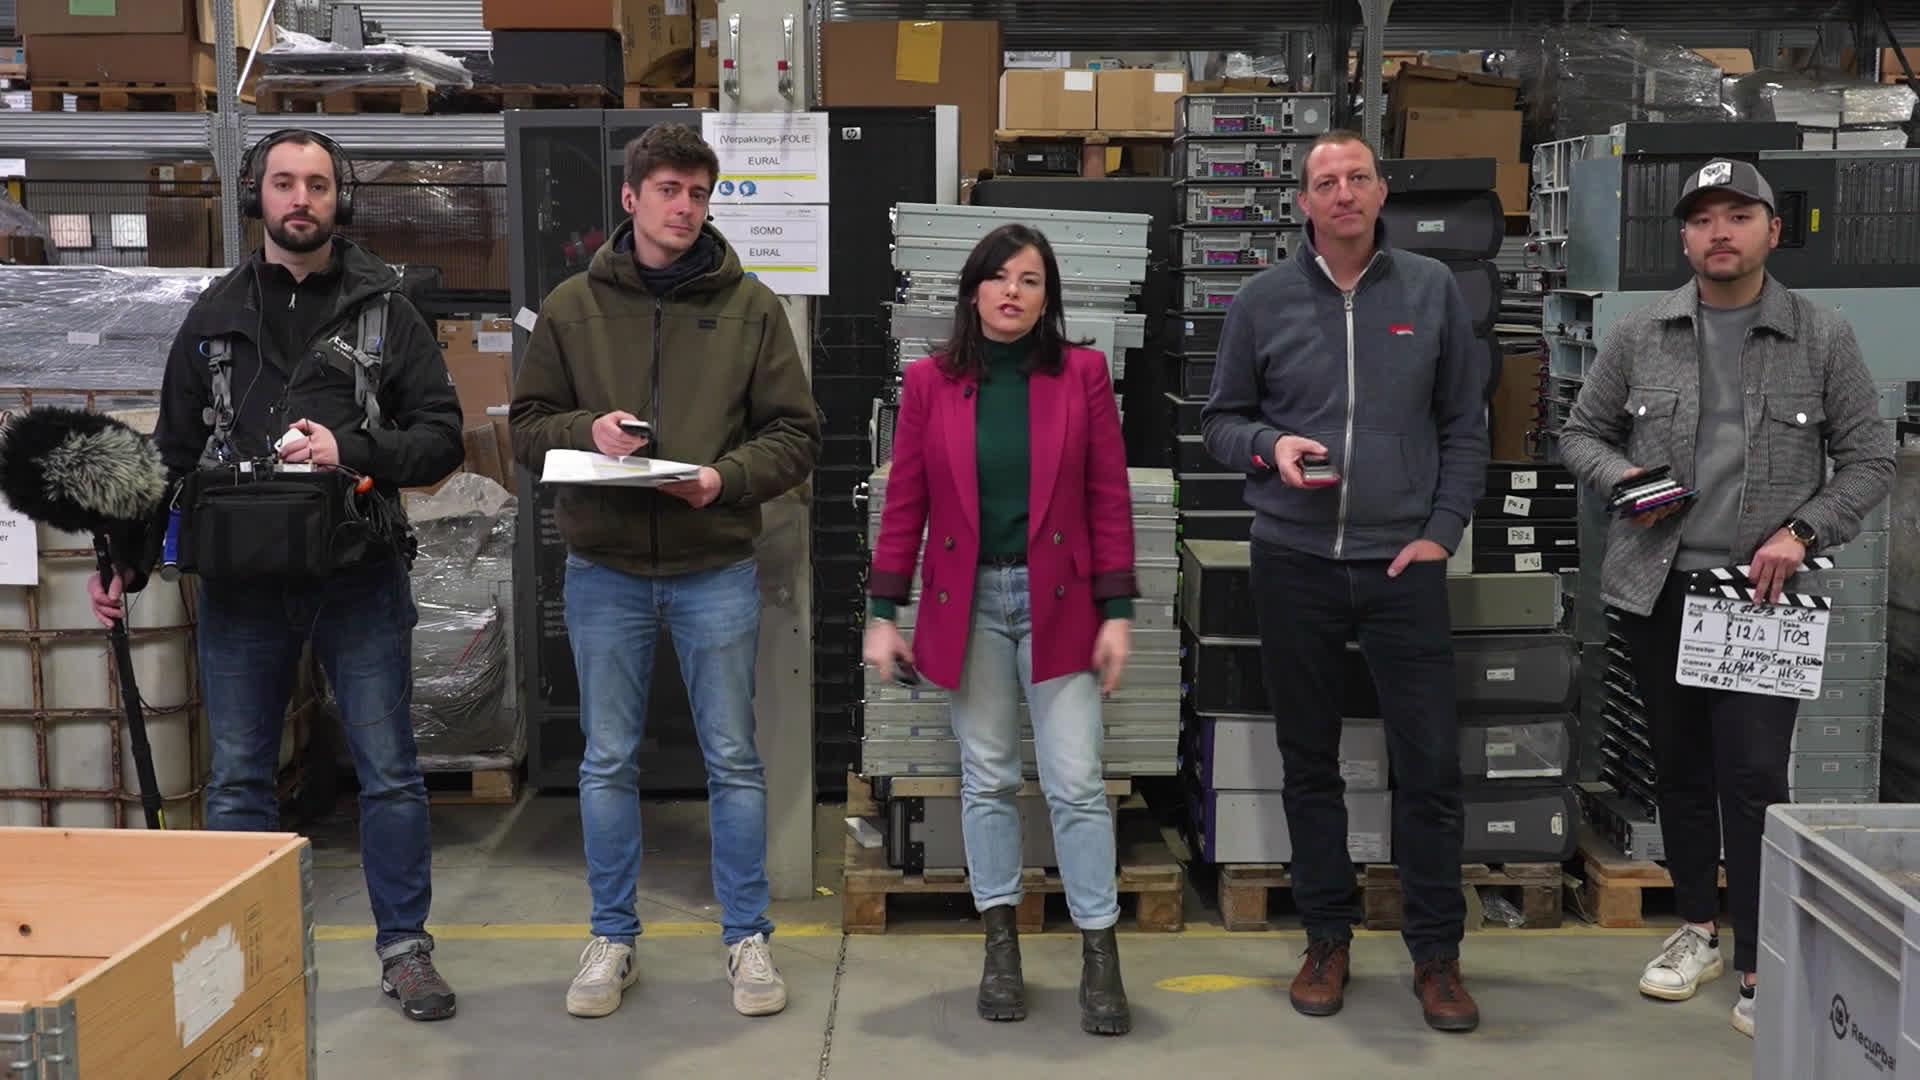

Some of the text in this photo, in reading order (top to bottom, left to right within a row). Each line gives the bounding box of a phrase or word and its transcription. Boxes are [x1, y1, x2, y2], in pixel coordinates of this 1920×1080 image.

[720, 135, 811, 144] (Verpakkings-)FOLIE
[748, 157, 781, 165] EURAL
[750, 226, 783, 235] ISOMO
[749, 248, 781, 257] EURAL
